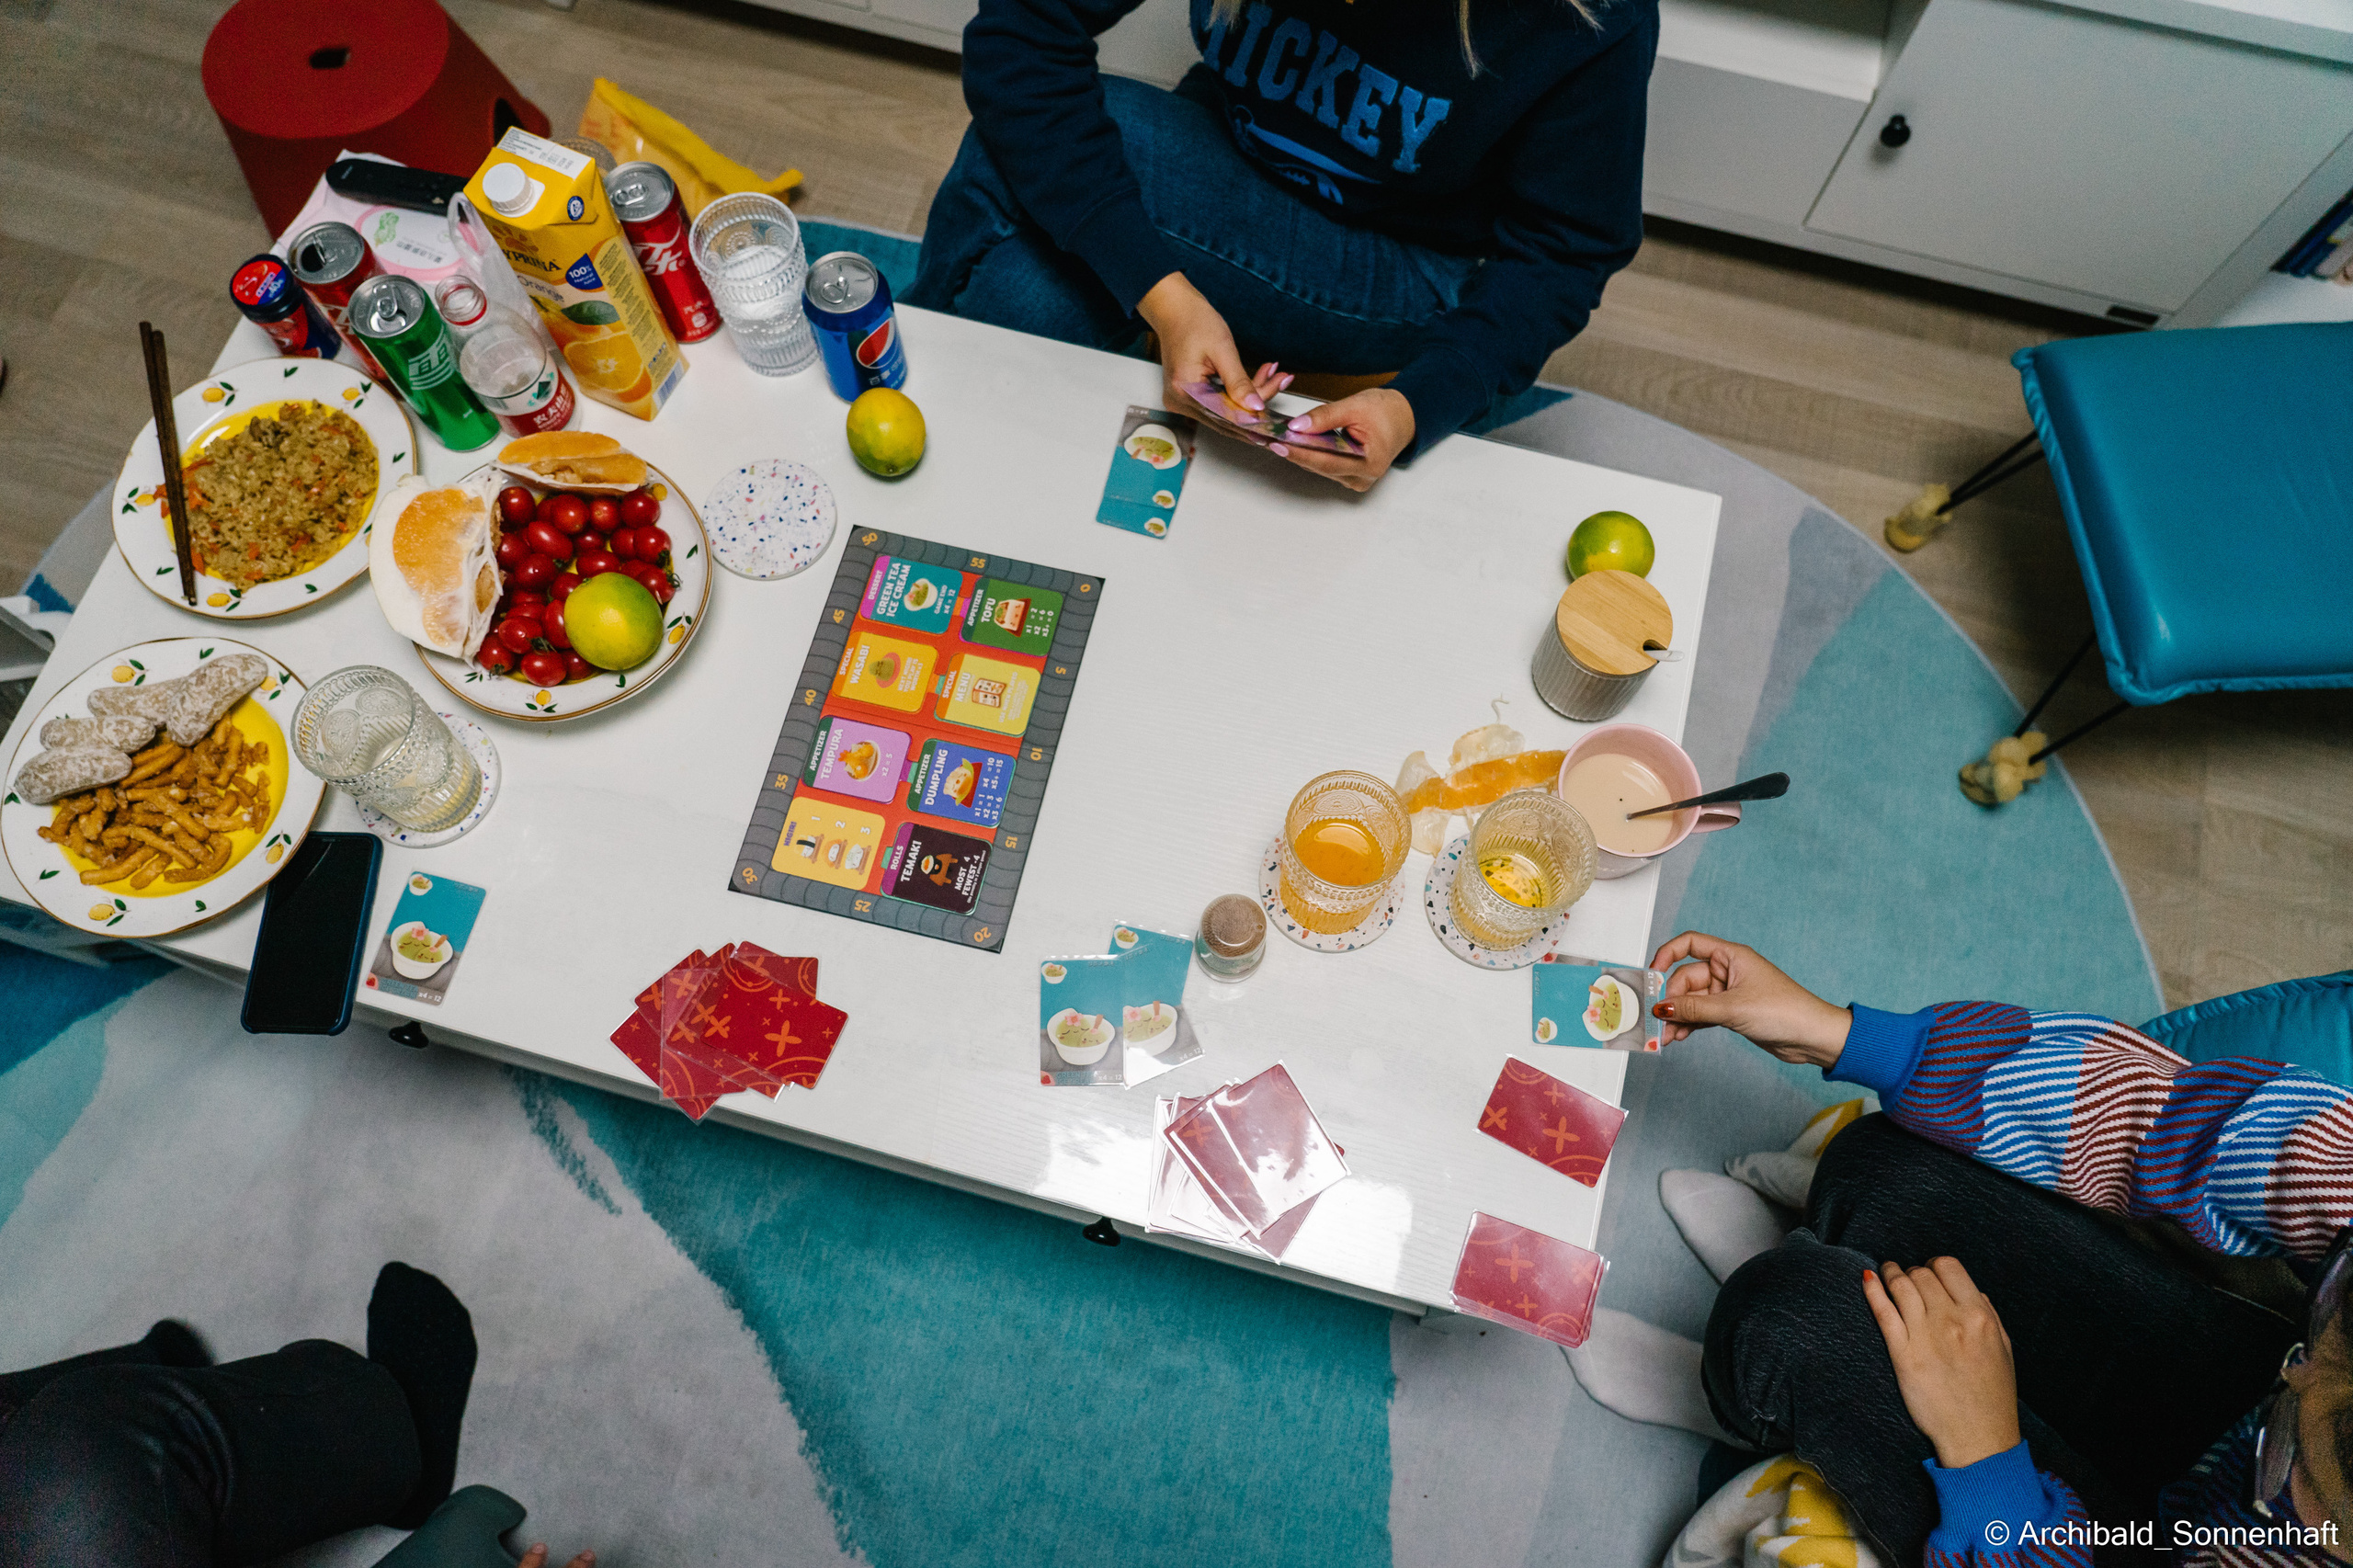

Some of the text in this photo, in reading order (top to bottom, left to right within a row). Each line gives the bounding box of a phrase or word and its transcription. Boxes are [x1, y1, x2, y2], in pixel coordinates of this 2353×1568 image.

[861, 531, 878, 546] 50
[971, 557, 985, 569] 55
[868, 569, 883, 600] DESSERT
[876, 561, 901, 615] GREEN TEA
[886, 563, 911, 617] ICE CREAM
[1080, 584, 1091, 593] 0
[934, 584, 948, 614] GAME END
[943, 604, 950, 614] x4
[948, 588, 955, 597] 12
[967, 588, 984, 626] APPETIZER
[833, 609, 846, 623] 45
[981, 597, 996, 623] TOFU
[1025, 624, 1032, 632] x1
[1033, 625, 1040, 634] x2
[839, 646, 854, 676] SPECIAL
[849, 643, 870, 684] WASABI
[1055, 666, 1066, 676] 5
[903, 680, 911, 692] YOU
[942, 669, 956, 699] SPECIAL
[954, 672, 971, 701] MENU
[804, 689, 817, 706] 40
[809, 730, 827, 770] APPETIZER
[820, 727, 844, 779] TEMPURA
[1030, 747, 1042, 760] 10
[881, 766, 890, 777] x2
[914, 753, 931, 794] APPETIZER
[924, 748, 949, 806] DUMPLING
[775, 774, 789, 790] 35
[972, 807, 982, 816] x1
[981, 777, 989, 788] x4
[982, 808, 990, 818] x2
[990, 810, 998, 820] x3
[783, 821, 797, 846] NIGIRI
[835, 820, 846, 828] 2
[859, 825, 870, 835] 3
[1006, 835, 1017, 848] 15
[890, 844, 904, 870] ROLLS
[900, 839, 922, 882] TEMAKI
[743, 867, 758, 883] 30
[954, 866, 967, 890] MOST
[961, 864, 977, 895] FEWEST
[855, 899, 870, 912] 25
[974, 927, 990, 942] 20
[1648, 985, 1654, 994] x4
